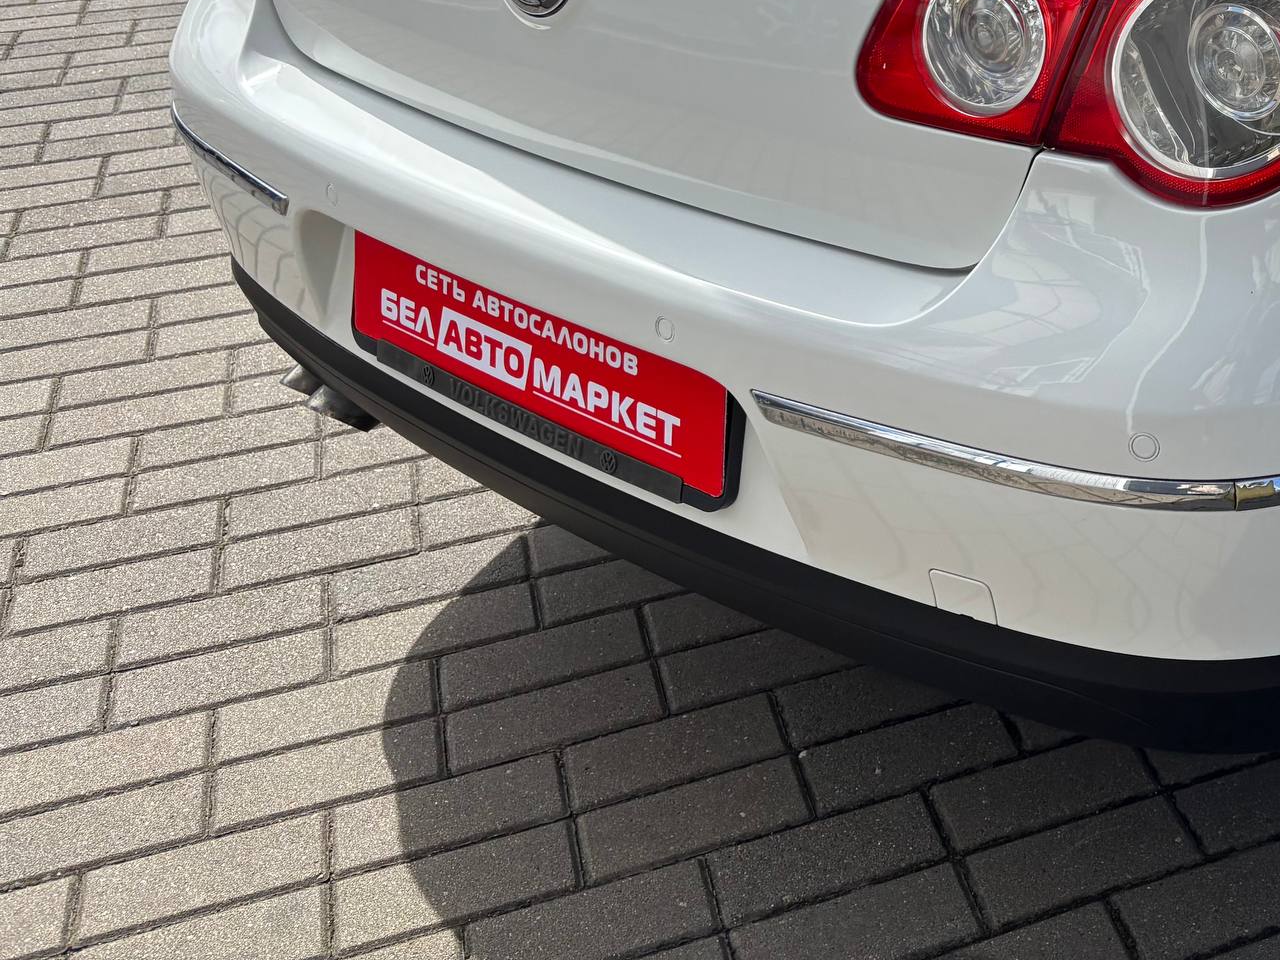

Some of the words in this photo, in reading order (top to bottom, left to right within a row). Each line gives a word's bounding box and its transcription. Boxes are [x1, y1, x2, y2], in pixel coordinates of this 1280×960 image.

[415, 264, 466, 301] СЕТЬ
[472, 290, 639, 376] АВТОСАЛОНОВ
[449, 378, 584, 458] VOLKSWAGEN
